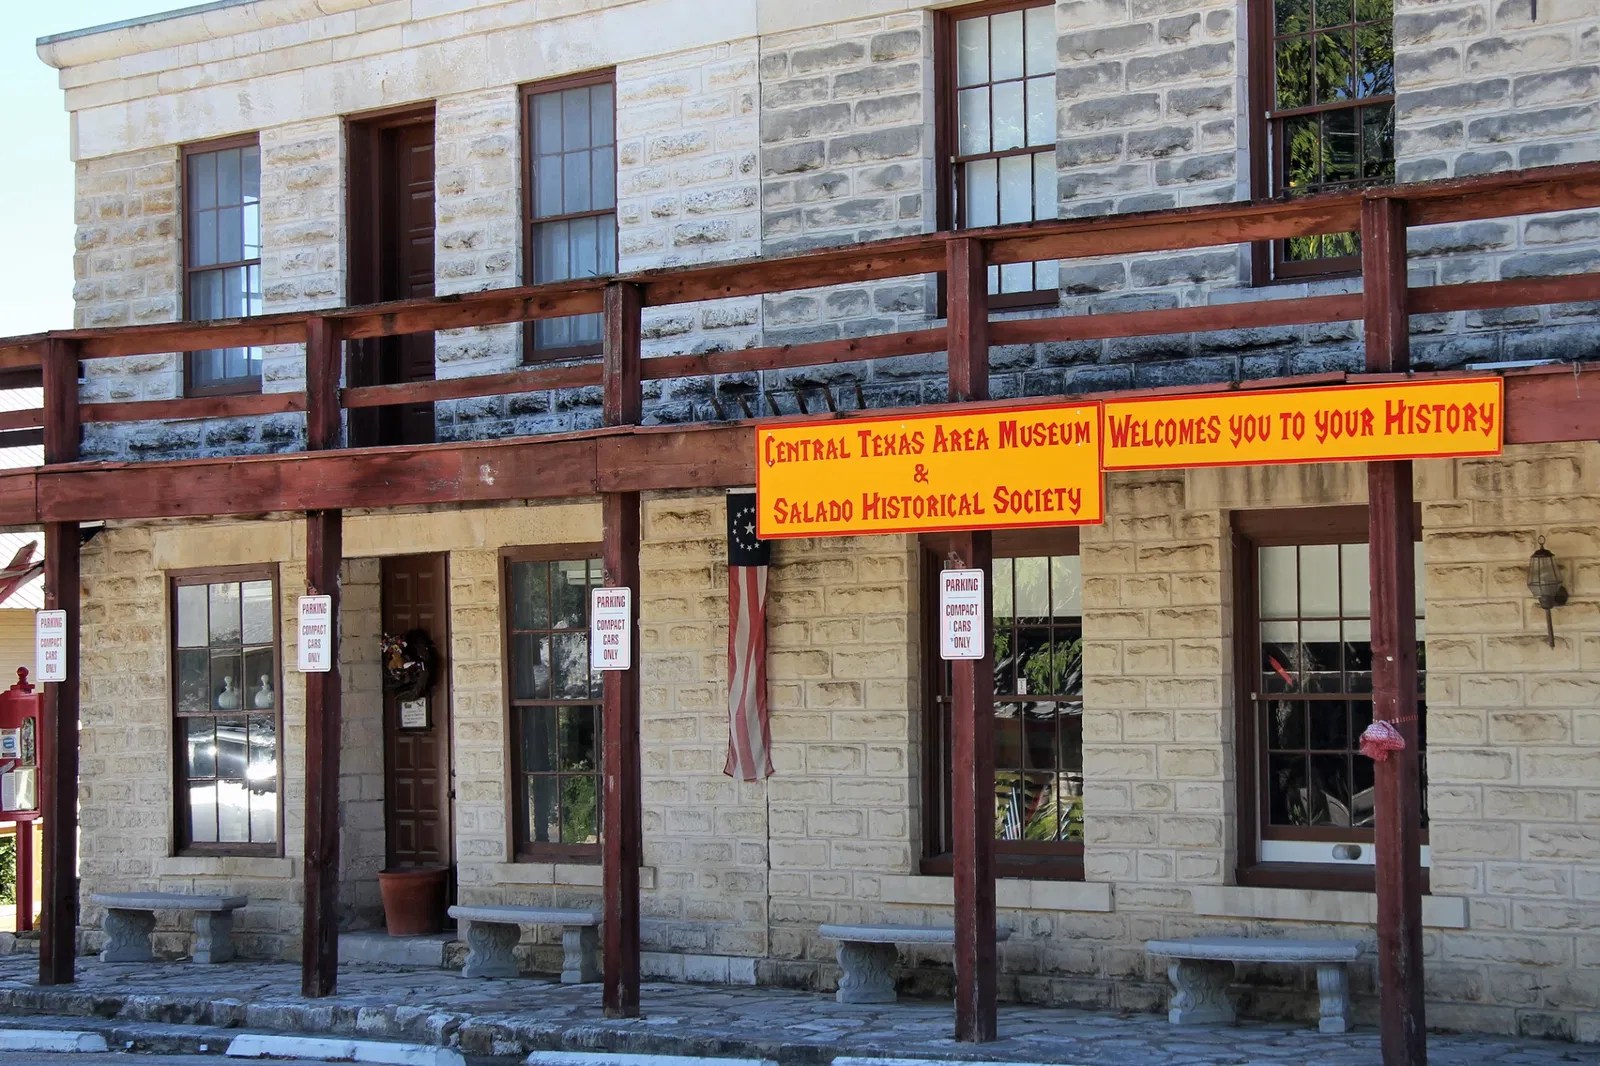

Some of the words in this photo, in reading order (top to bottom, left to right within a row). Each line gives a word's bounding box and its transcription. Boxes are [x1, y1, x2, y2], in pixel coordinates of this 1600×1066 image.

[1107, 413, 1222, 448] WELCOMES
[1279, 411, 1305, 440] TO
[1383, 399, 1495, 437] HISTORY
[764, 435, 851, 468] CENTRAL
[857, 429, 925, 458] TEXAS
[932, 424, 990, 453] AREA
[997, 420, 1092, 450] MUSEUM
[913, 463, 929, 484] &
[773, 496, 854, 525] SALADO
[861, 491, 986, 521] HISTORICAL
[992, 485, 1082, 515] SOCIETY
[946, 578, 979, 592] PARKING
[597, 595, 626, 608] PARKING
[302, 603, 327, 614] PARKING
[945, 604, 978, 617] COMPACT
[41, 617, 62, 628] PARKING
[596, 619, 625, 631] COMPACT
[953, 620, 971, 633] CARS
[302, 625, 327, 635] COMPACT
[41, 637, 62, 647] COMPACT
[307, 639, 321, 649] CARS
[603, 634, 619, 645] CARS
[954, 637, 971, 649] ONLY
[45, 650, 57, 660] CARS
[308, 652, 320, 662] ONLY
[603, 649, 618, 660] ONLY
[45, 663, 57, 673] ONLY
